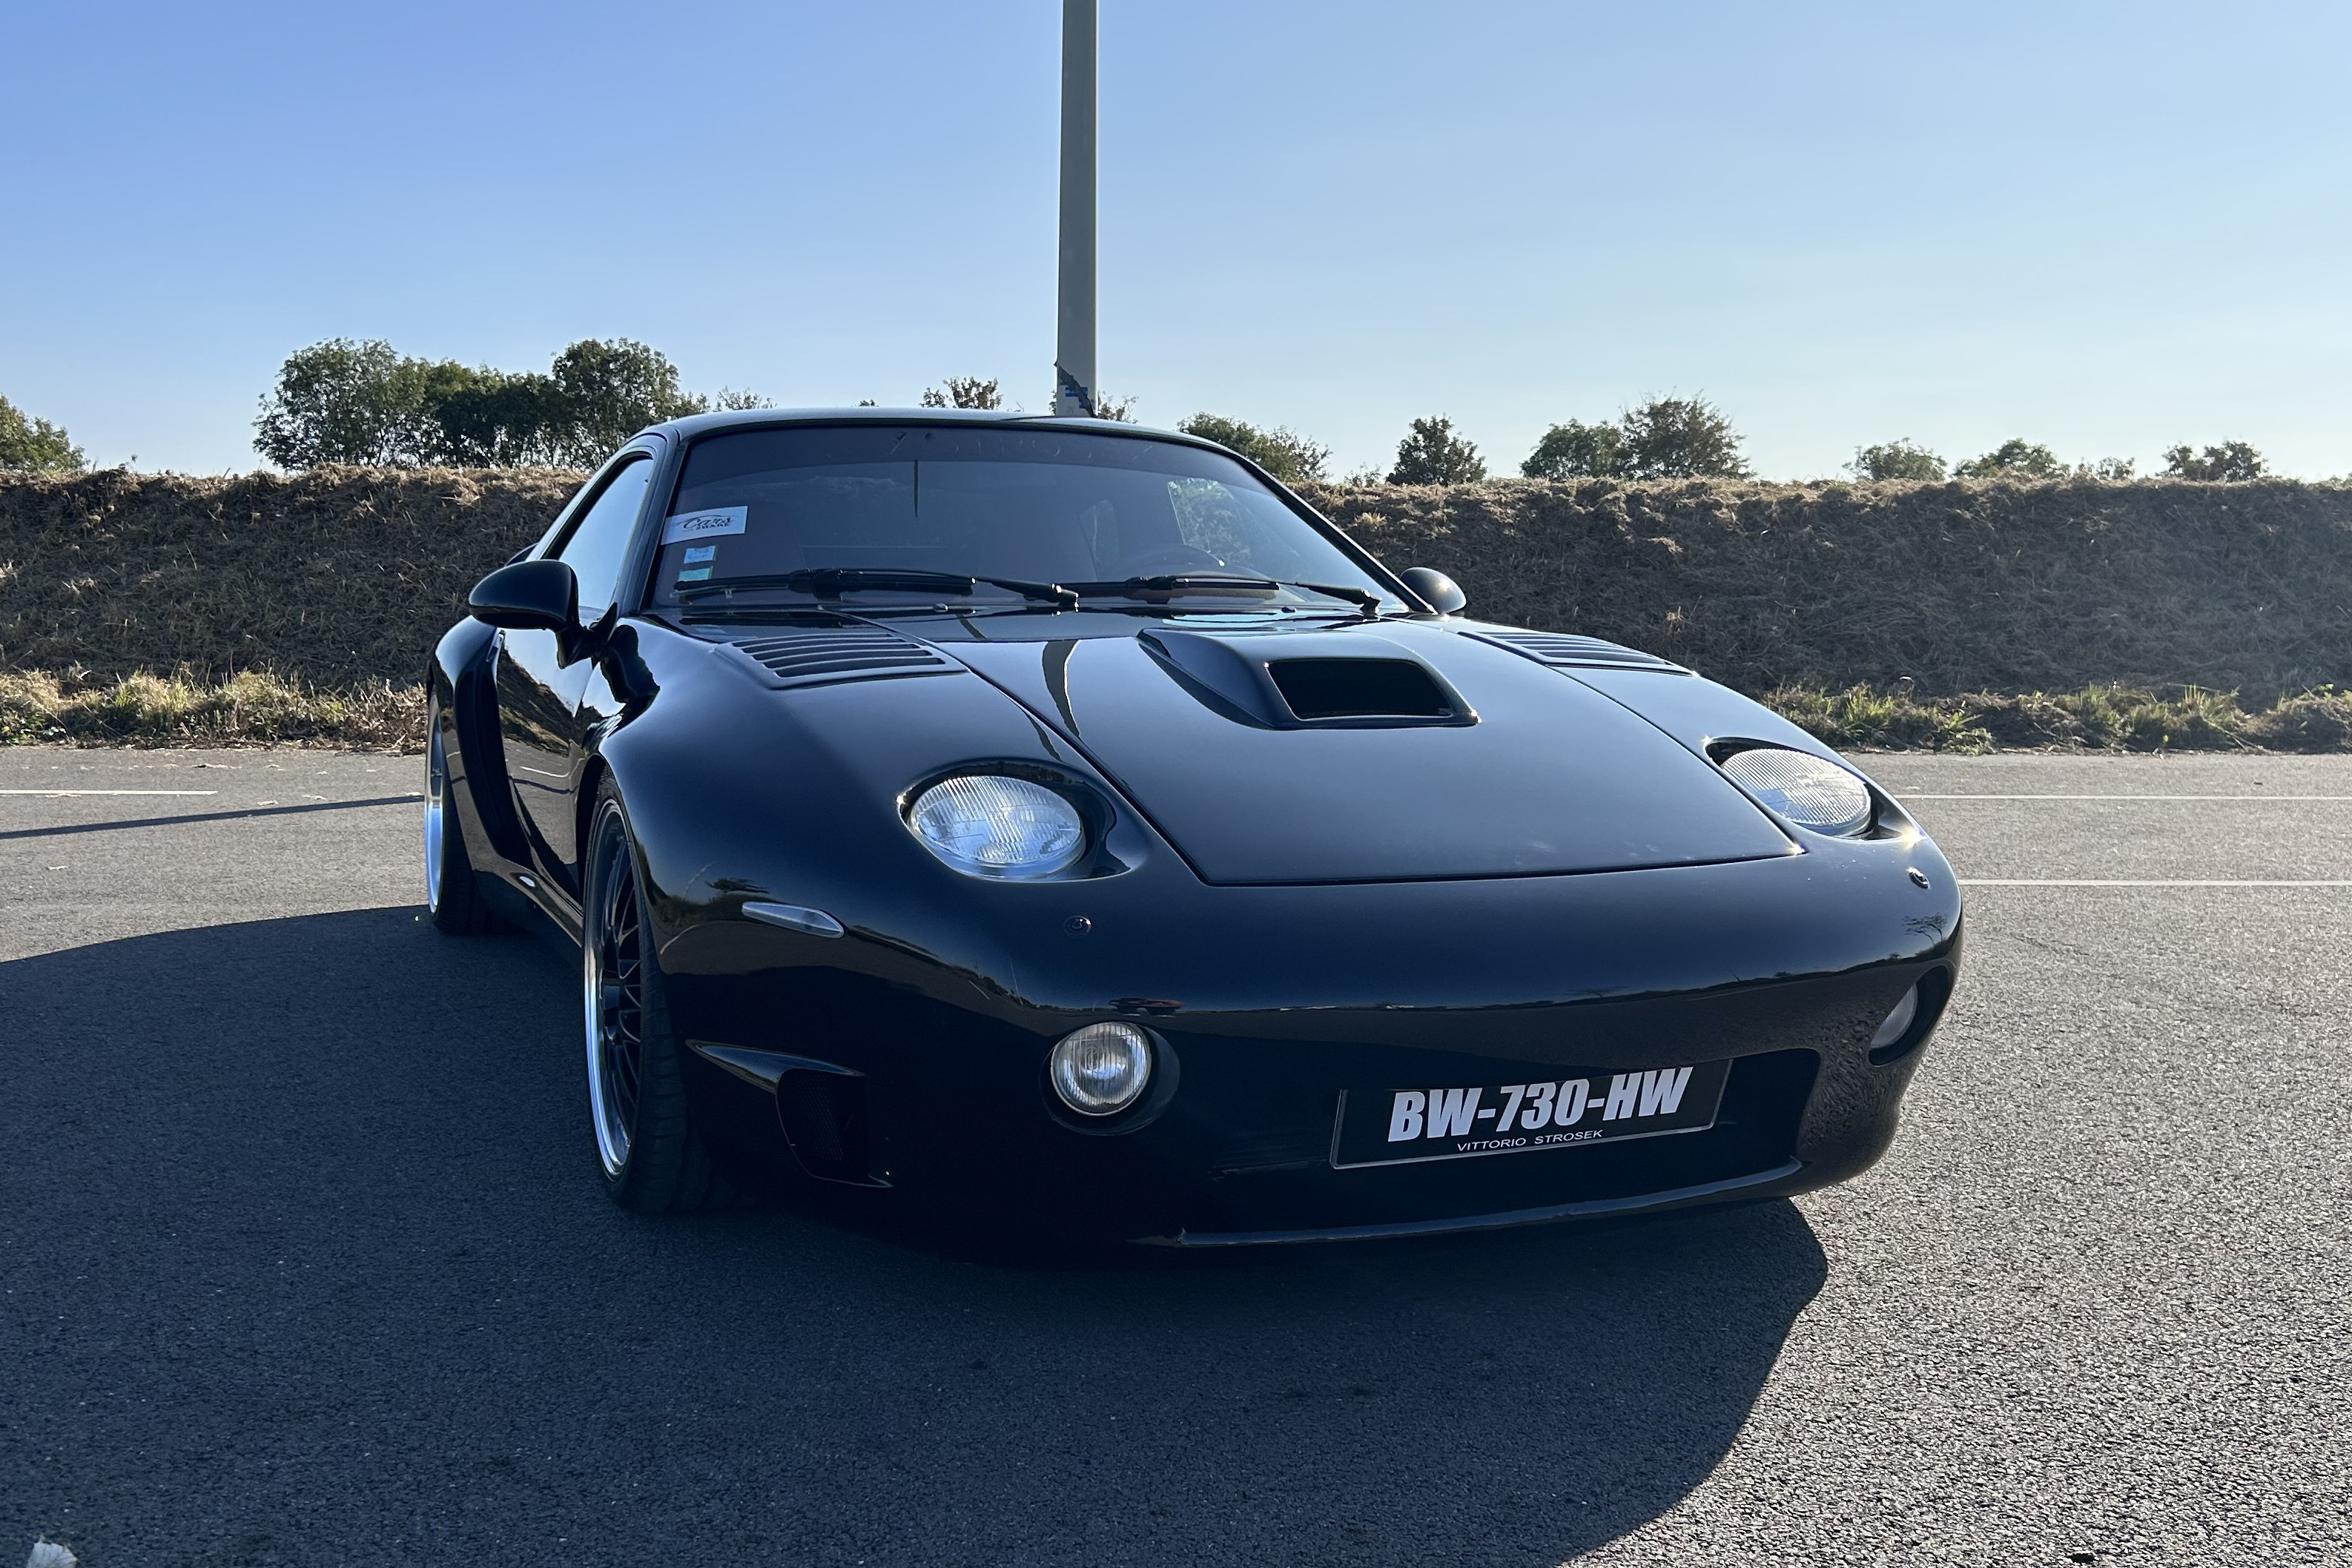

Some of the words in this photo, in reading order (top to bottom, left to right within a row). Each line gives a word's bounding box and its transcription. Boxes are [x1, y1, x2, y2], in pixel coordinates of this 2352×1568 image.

[1387, 1066, 1694, 1142] BW-730-HW
[1457, 1139, 1527, 1151] VITTORIO
[1534, 1129, 1604, 1145] STROSEK
